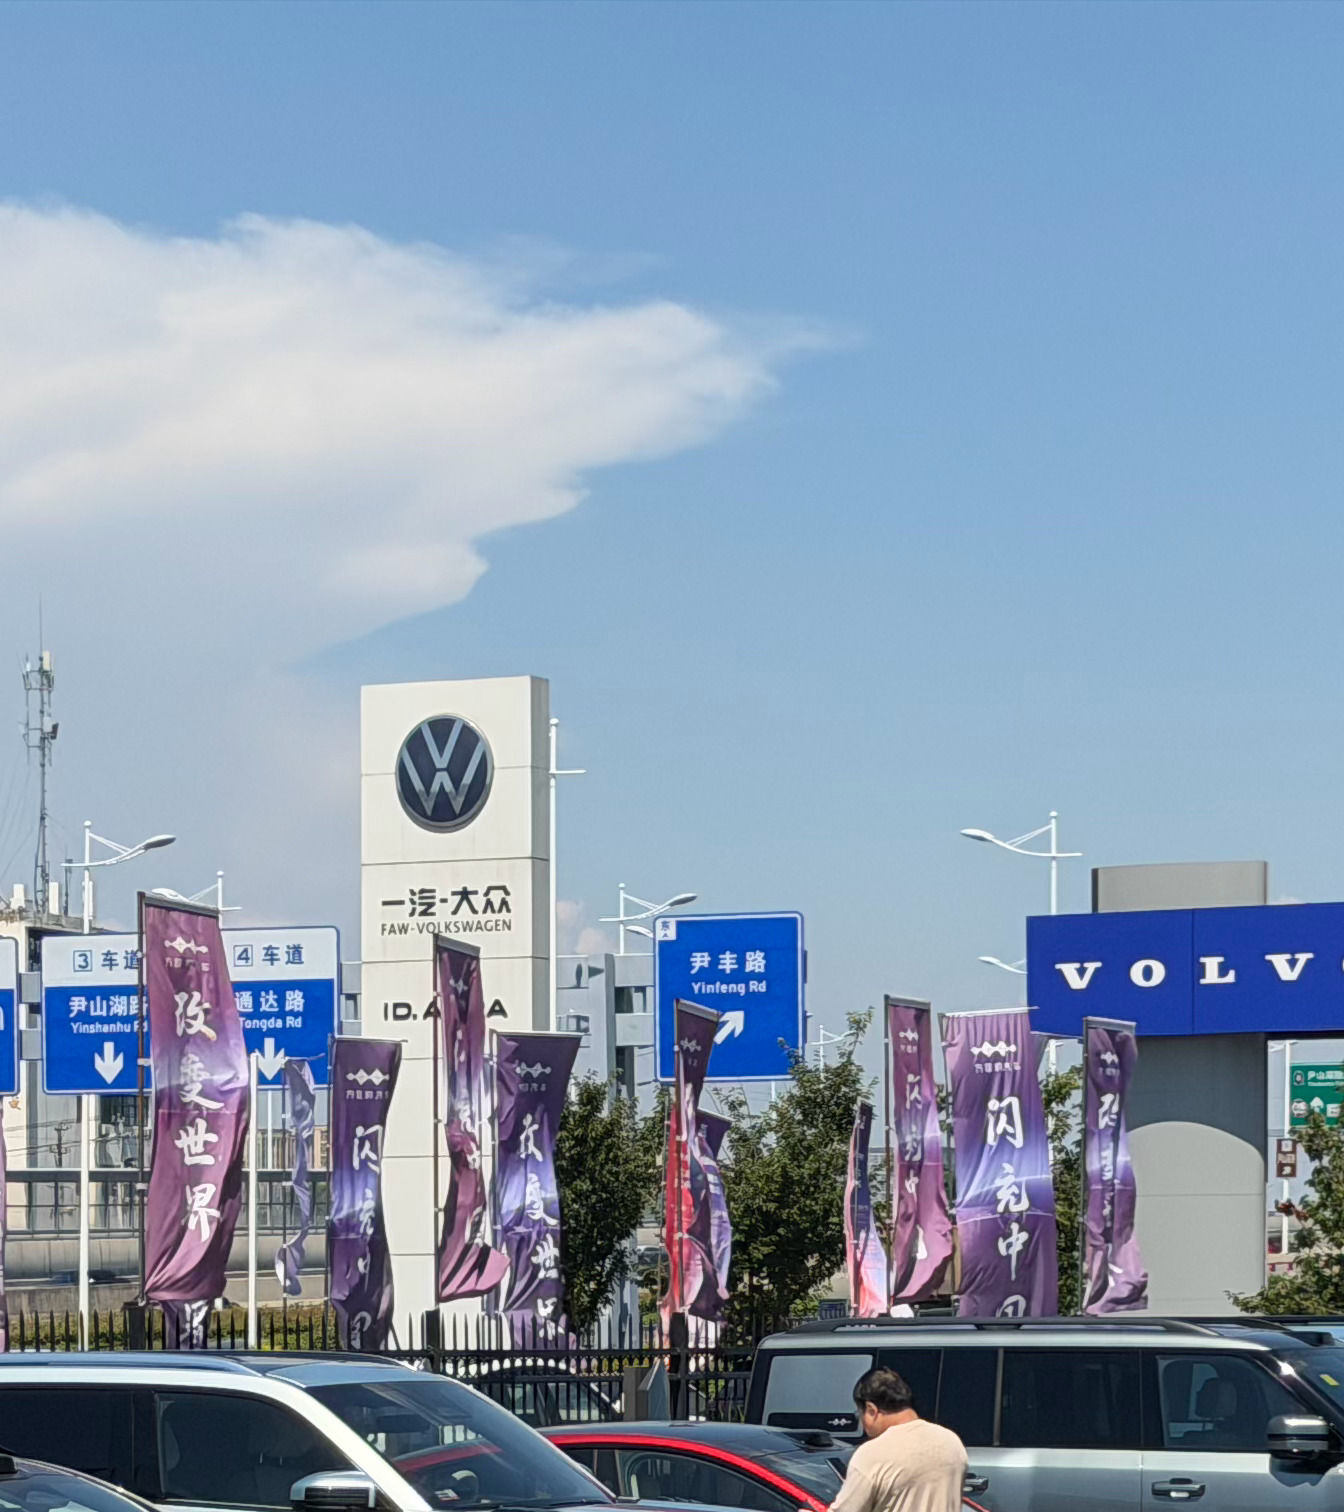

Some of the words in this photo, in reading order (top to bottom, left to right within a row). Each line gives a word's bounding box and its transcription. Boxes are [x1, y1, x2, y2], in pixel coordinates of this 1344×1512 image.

[381, 885, 511, 917] 一汽-大众
[381, 919, 512, 936] FAW-VOLKSWAGEN
[262, 944, 305, 966] 车道
[690, 950, 766, 975] 尹丰路
[691, 981, 746, 996] Yinfeng
[749, 980, 767, 992] Rd
[71, 1021, 131, 1034] Yinshanhu
[286, 1016, 302, 1028] Rd
